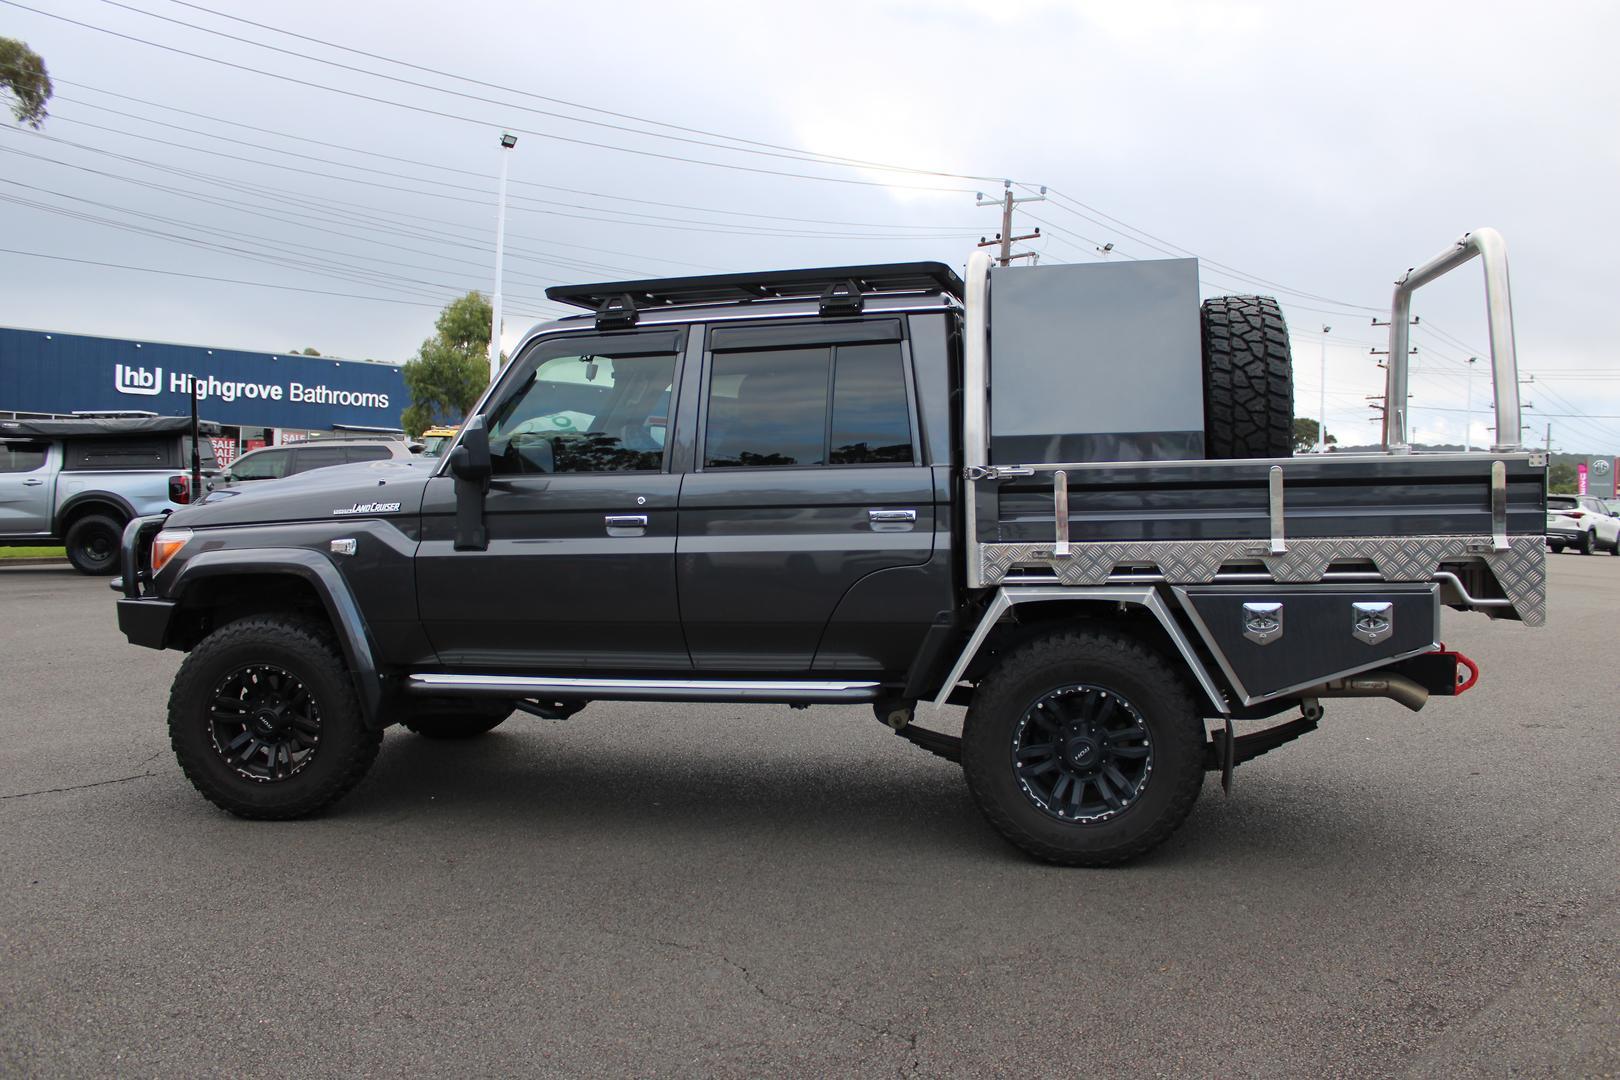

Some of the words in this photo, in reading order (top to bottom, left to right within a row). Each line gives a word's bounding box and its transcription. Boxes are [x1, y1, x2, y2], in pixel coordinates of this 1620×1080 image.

[170, 372, 283, 402] Highgrove
[289, 382, 389, 408] Bathrooms
[211, 440, 235, 449] SALE
